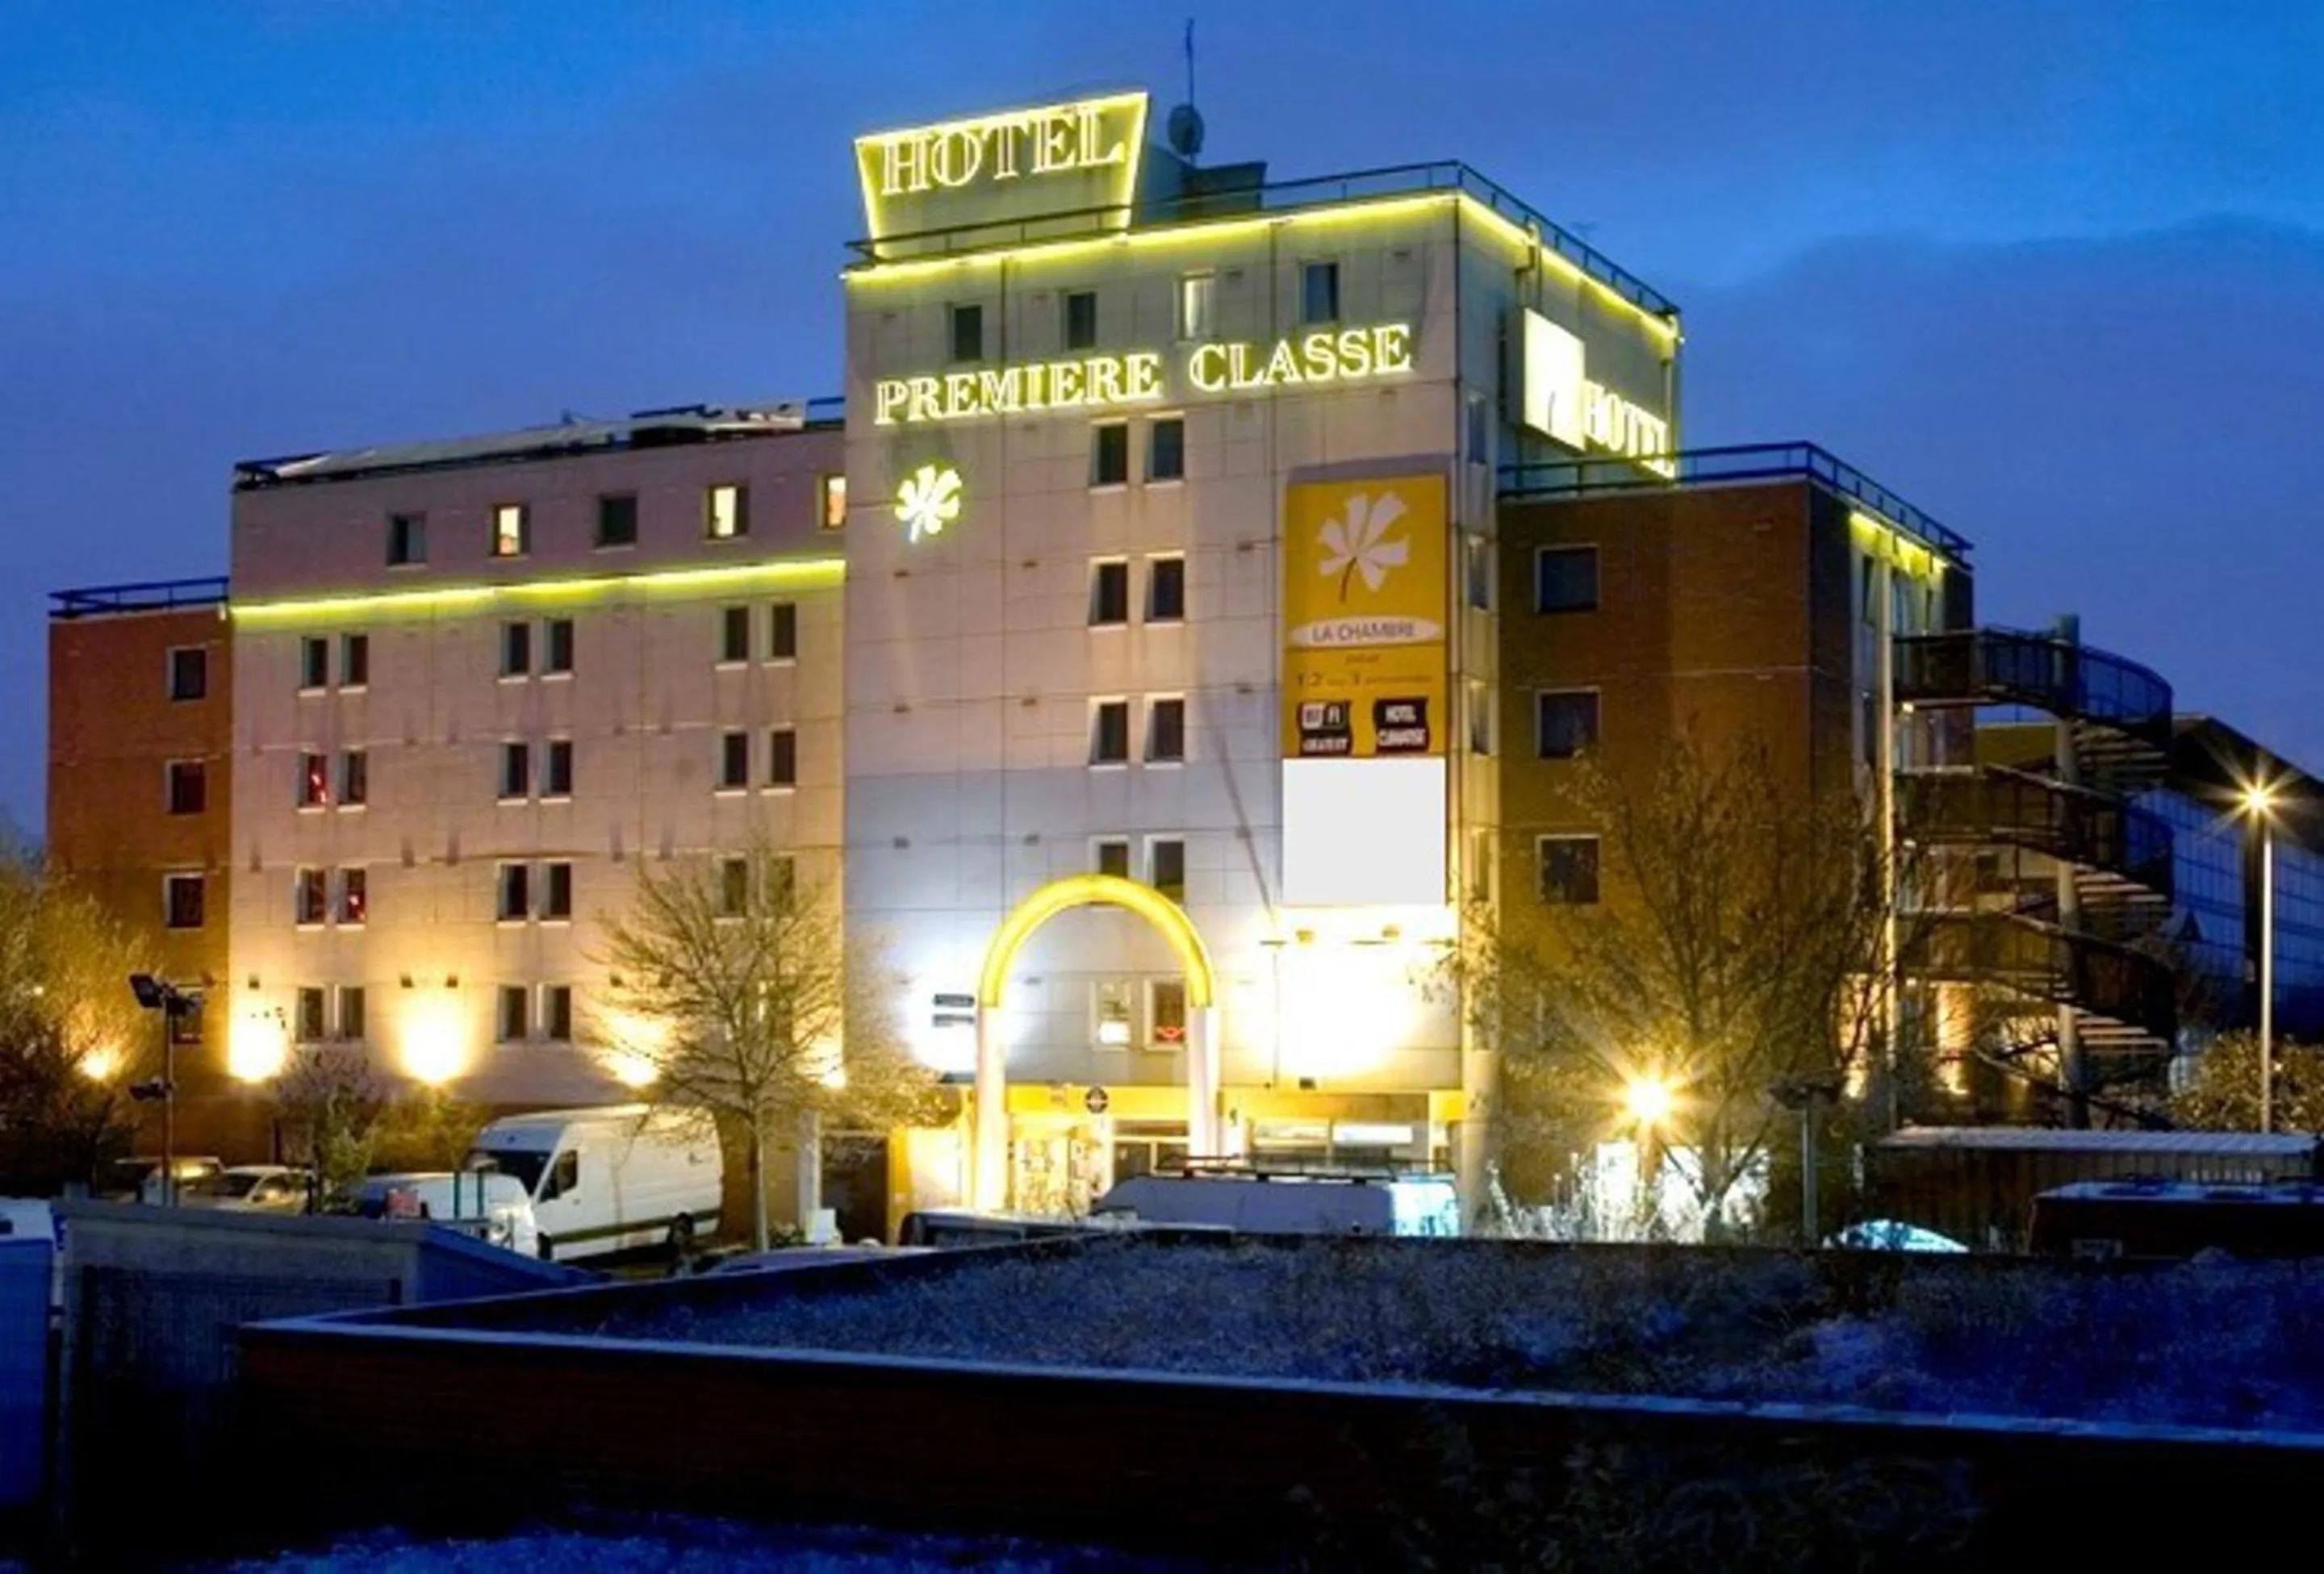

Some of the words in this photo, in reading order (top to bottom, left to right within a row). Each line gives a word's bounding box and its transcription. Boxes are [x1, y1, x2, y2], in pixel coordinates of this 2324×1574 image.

[881, 108, 1126, 195] HOTEL
[874, 352, 1164, 426] PREMIERE
[1188, 324, 1412, 391] CLASSE
[1312, 624, 1333, 643] LA
[1337, 622, 1416, 642] CHAMBRE
